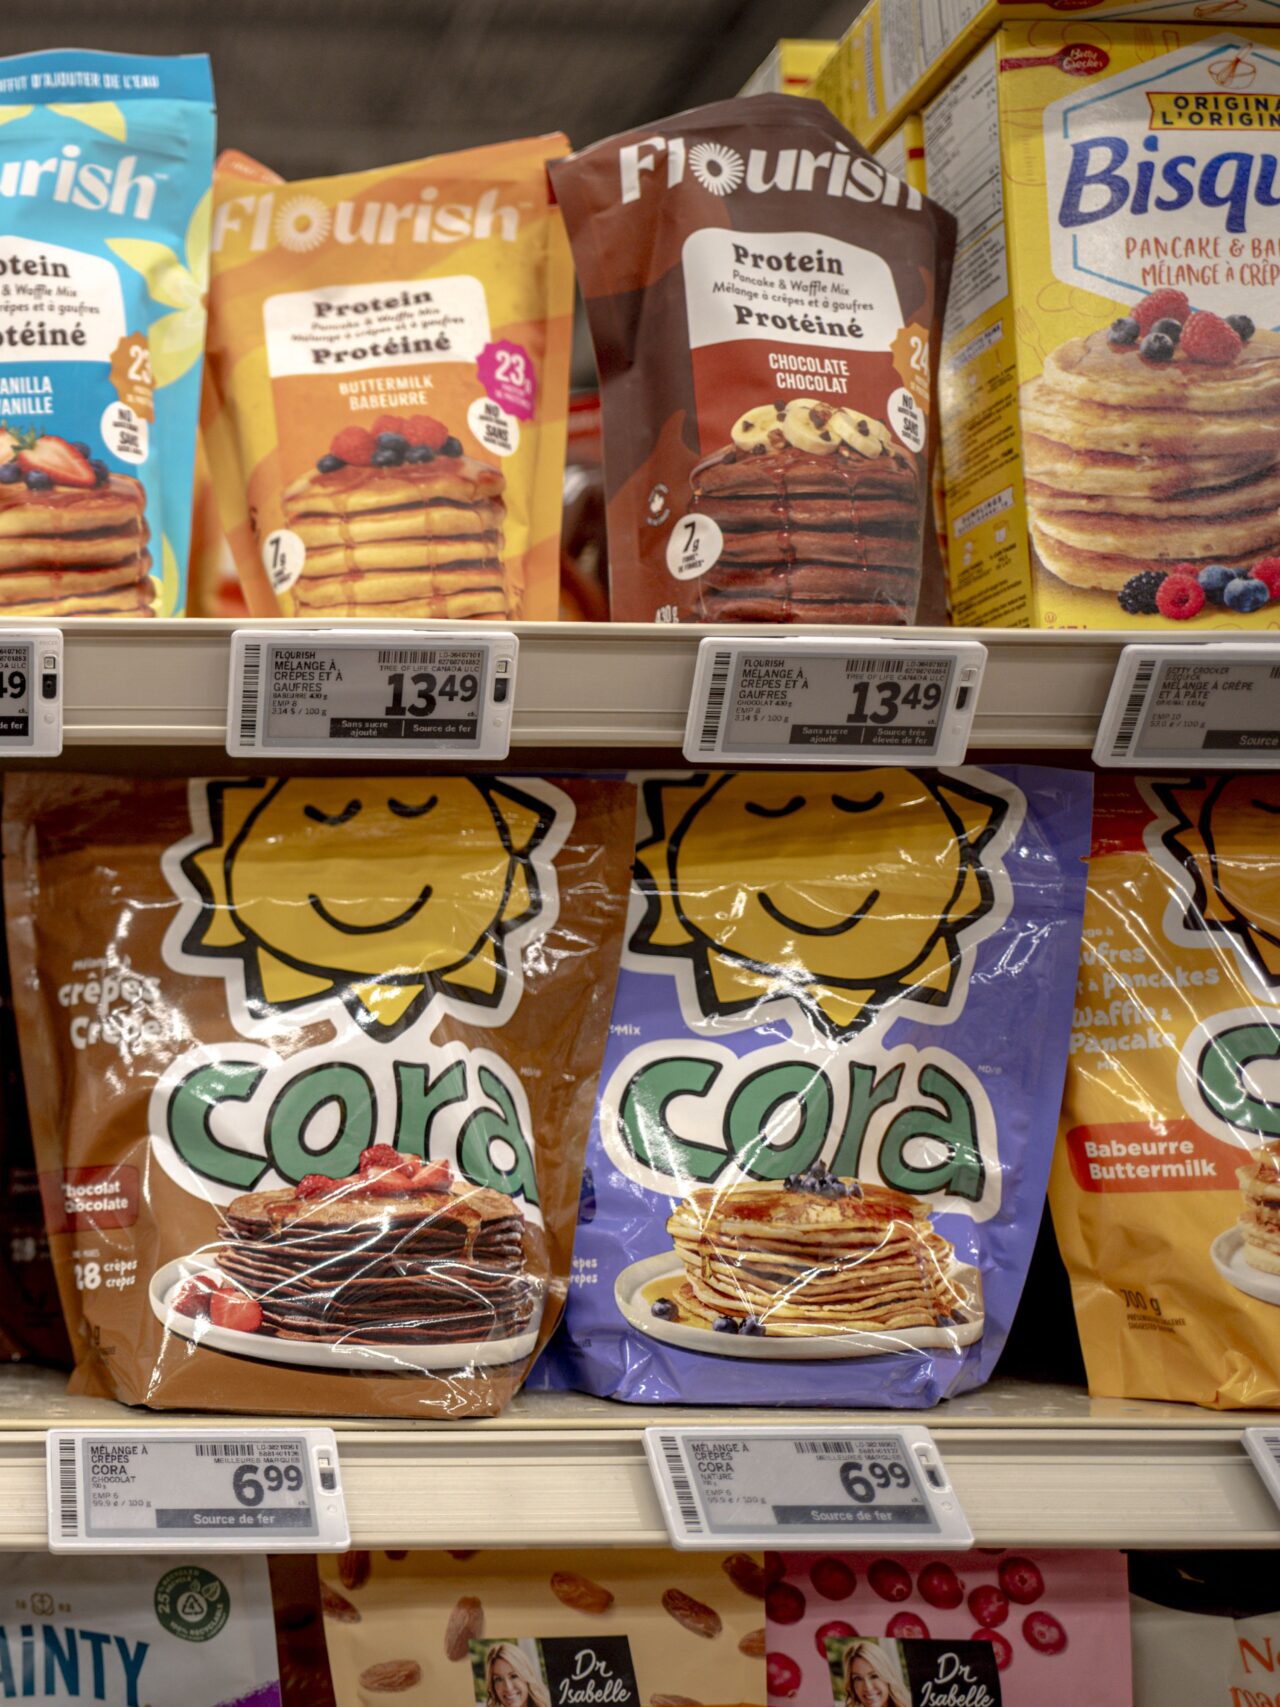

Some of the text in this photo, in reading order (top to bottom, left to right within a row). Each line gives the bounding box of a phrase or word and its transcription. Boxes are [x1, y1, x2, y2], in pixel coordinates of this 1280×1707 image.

[31, 72, 100, 89] D'AJOUTER
[103, 74, 120, 89] DE
[123, 74, 159, 89] L'EAU
[212, 187, 518, 252] Flourish
[1125, 237, 1280, 259] PANCAKE & BA
[732, 244, 844, 276] Protein
[733, 269, 850, 296] Pancake & Waffle Mix
[1142, 260, 1218, 287] MÉLANGE
[1225, 261, 1235, 281] À
[1, 284, 11, 297] &
[15, 283, 56, 299] Waffle
[59, 284, 77, 298] Mix
[313, 290, 433, 318] Protein
[734, 305, 864, 338] Protéiné
[311, 332, 450, 365] Protéiné
[769, 353, 850, 376] CHOCOLATE
[338, 375, 433, 396] BUTTERMILK
[776, 372, 848, 394] CHOCOLAT
[349, 392, 428, 411] BABEURRE
[273, 683, 322, 692] GAUFRES
[739, 690, 787, 699] GAUFRES
[1239, 736, 1279, 746] Source
[1103, 966, 1220, 999] pancakes
[165, 1059, 540, 1207] cora
[619, 1056, 985, 1202] cora
[1084, 1140, 1194, 1158] Babeurre
[1088, 1161, 1217, 1180] Buttermilk
[1120, 1288, 1161, 1316] 700 g
[92, 1465, 127, 1475] CORA
[698, 1462, 734, 1472] CORA
[92, 1476, 136, 1484] CHOCOLAT
[193, 1514, 275, 1525] Source de fer
[810, 1510, 892, 1521] Source de fer
[570, 1649, 612, 1681] Dr
[934, 1651, 977, 1684] Dr
[558, 1679, 631, 1705] Isabelle
[920, 1681, 994, 1707] Isabelle
